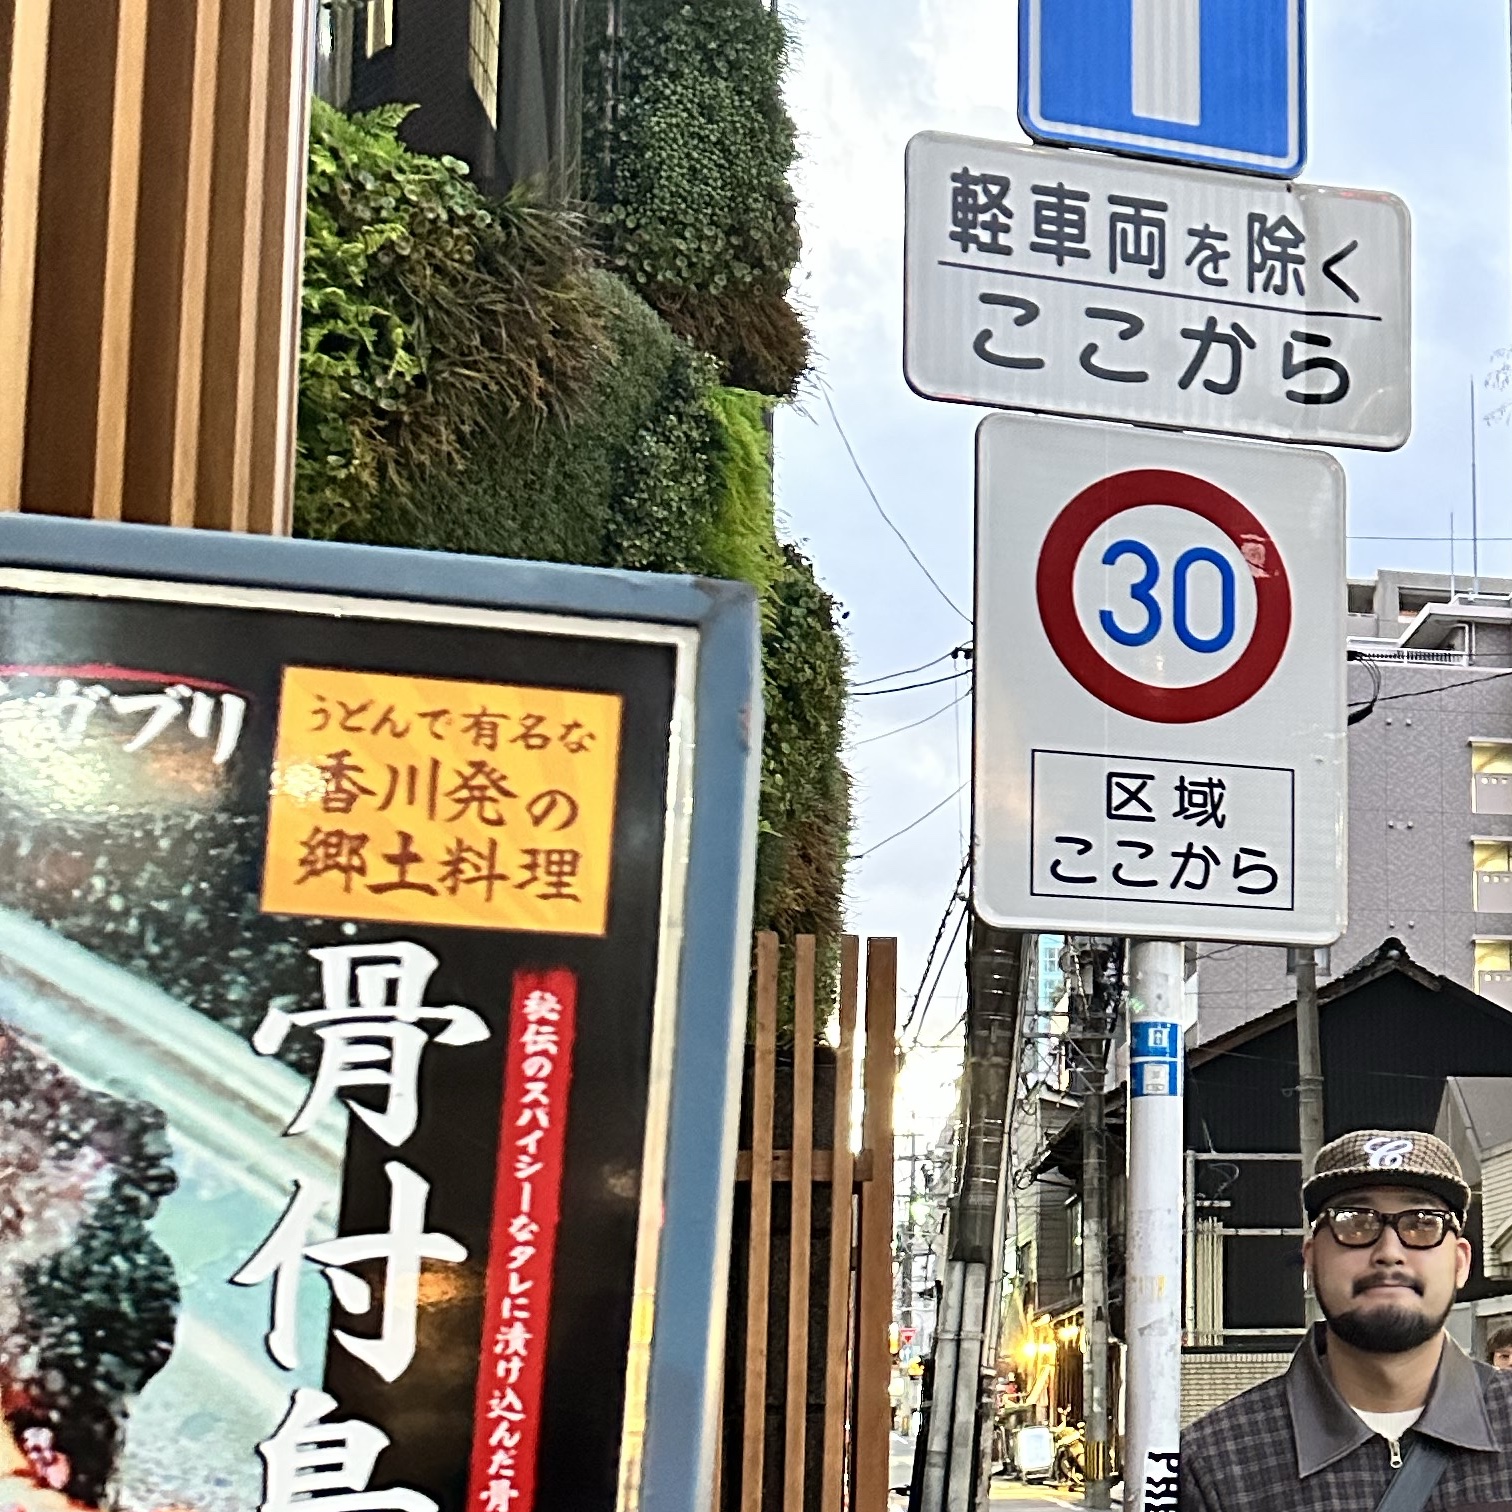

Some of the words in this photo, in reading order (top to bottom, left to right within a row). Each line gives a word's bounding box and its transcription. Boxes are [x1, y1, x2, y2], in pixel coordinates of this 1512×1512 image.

[949, 166, 1359, 303] 軽車両を除く
[973, 292, 1350, 405] ここから
[1099, 539, 1235, 653] 30
[316, 749, 580, 832] 香川発の
[1106, 771, 1227, 829] 区域
[294, 825, 582, 903] 郷土料理
[1050, 835, 1279, 895] ここから
